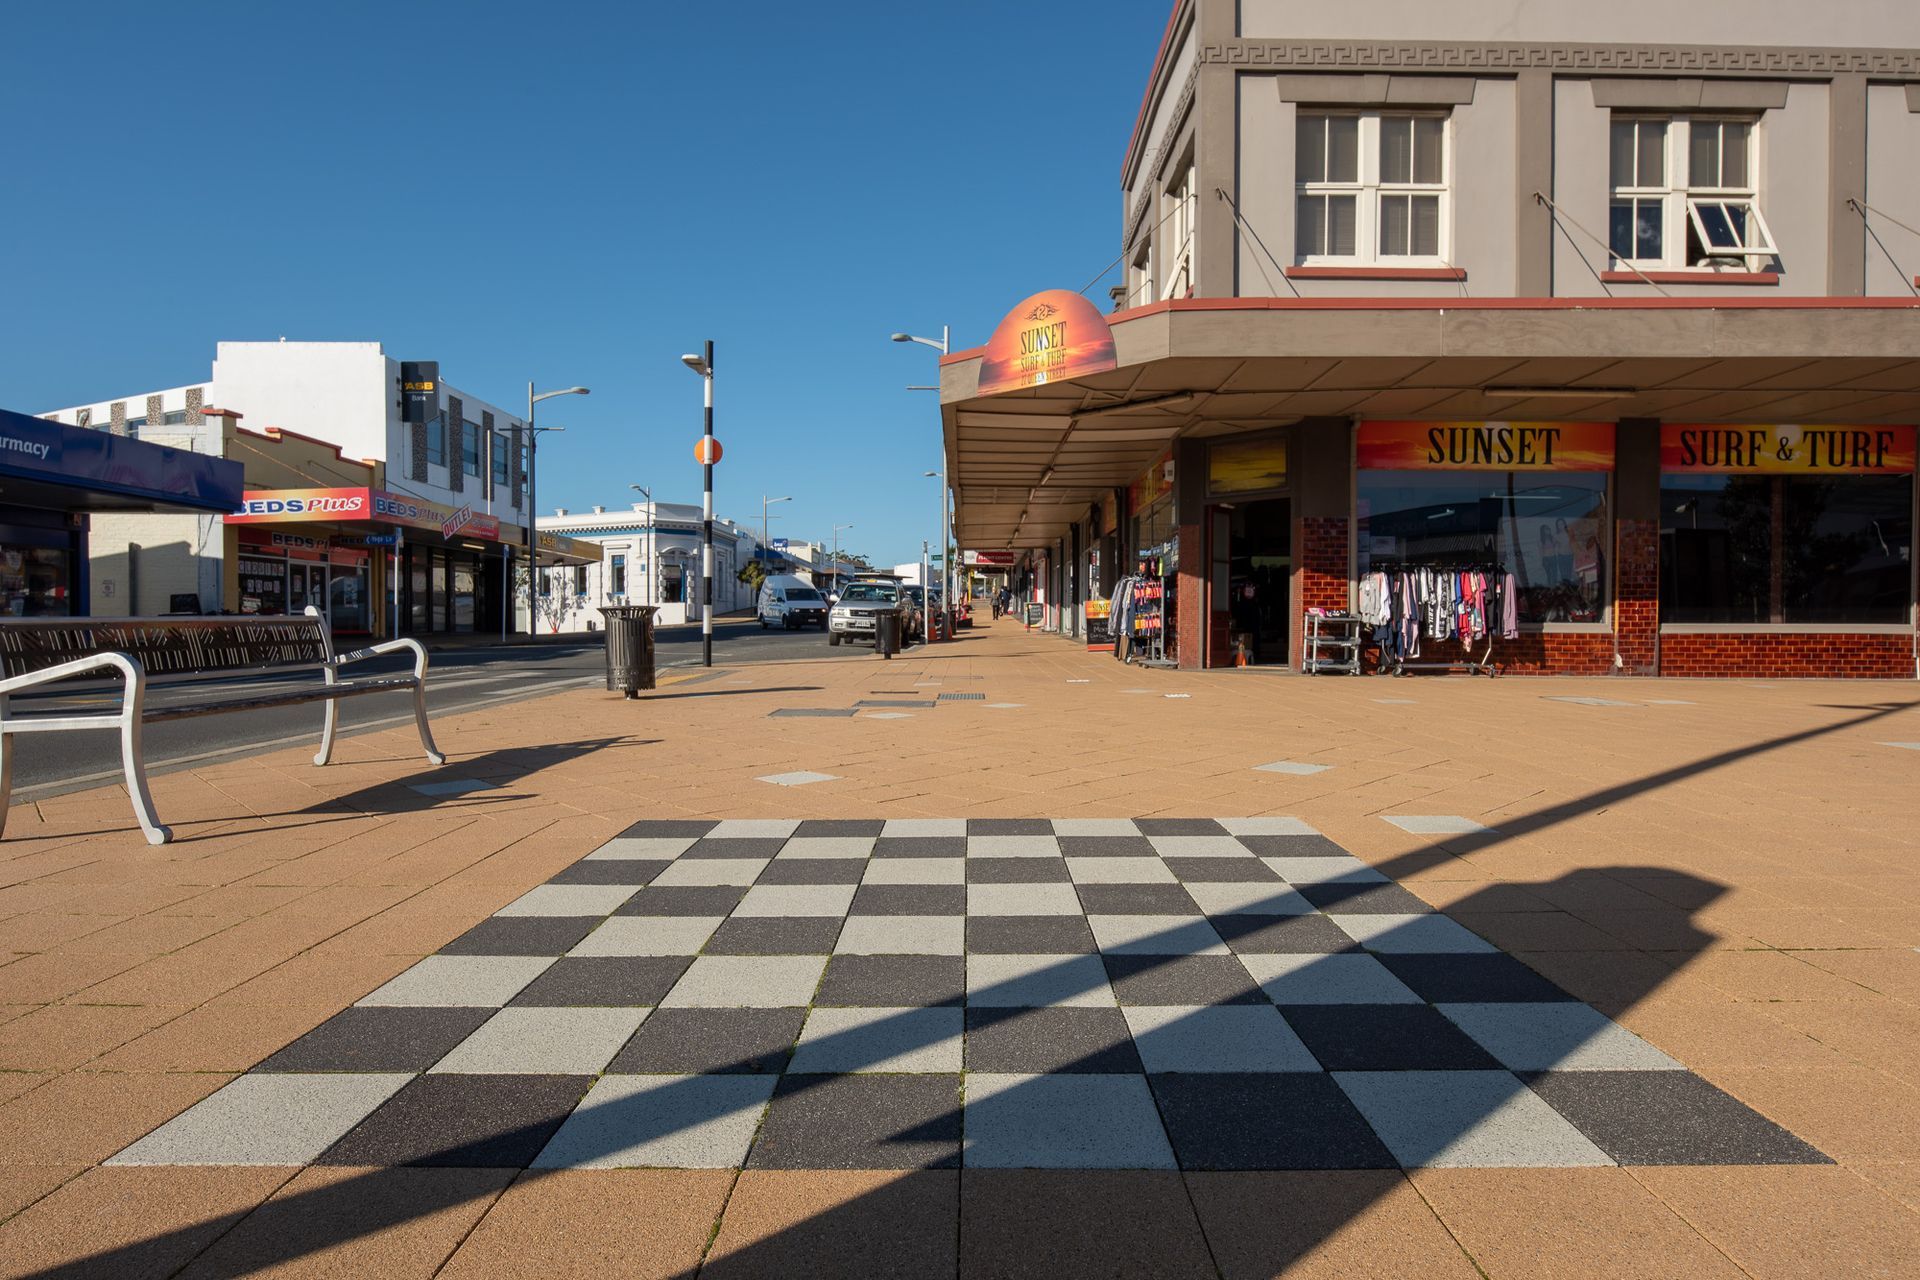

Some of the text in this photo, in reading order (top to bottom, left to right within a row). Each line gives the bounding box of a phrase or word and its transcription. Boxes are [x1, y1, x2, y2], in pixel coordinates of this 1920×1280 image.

[1020, 321, 1067, 355] SUNSET
[1020, 355, 1040, 373] SURF
[1045, 348, 1067, 368] TURF
[404, 381, 434, 391] ASB
[1428, 427, 1561, 465] SUNSET
[1679, 429, 1895, 468] SURF & TURF
[307, 496, 362, 512] Plus
[375, 497, 447, 522] BEDS Plus
[443, 506, 473, 537] OUTLET
[273, 533, 314, 548] BEDS
[542, 536, 557, 548] ASB
[1092, 603, 1110, 611] SUNSE
